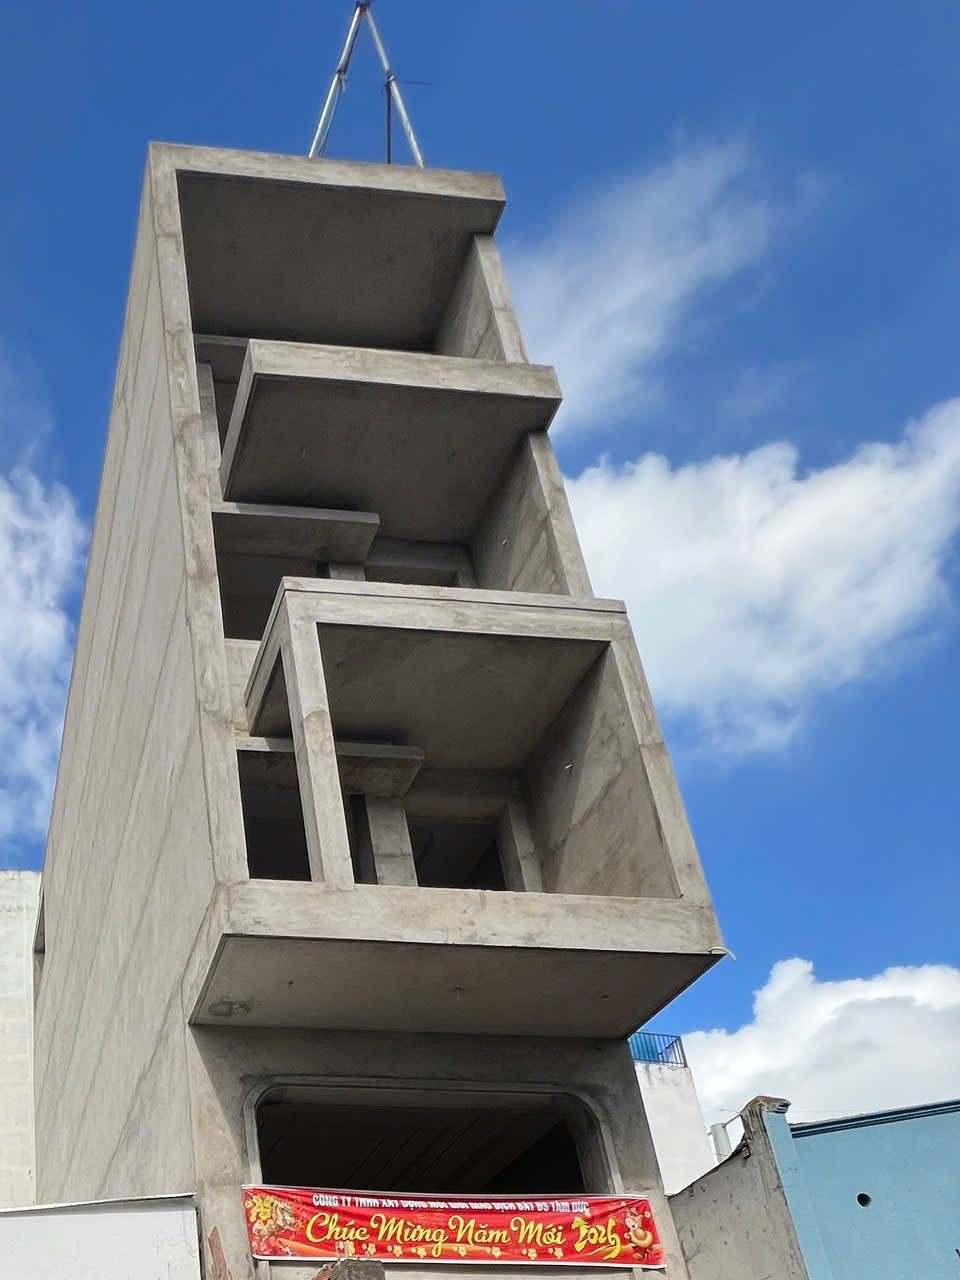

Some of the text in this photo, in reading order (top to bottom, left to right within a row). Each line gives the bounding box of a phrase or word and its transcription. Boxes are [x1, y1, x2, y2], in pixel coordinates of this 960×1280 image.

[306, 1212, 370, 1243] Chúc
[370, 1213, 448, 1257] Mừng
[448, 1215, 510, 1247] Năm
[510, 1216, 566, 1247] Mới
